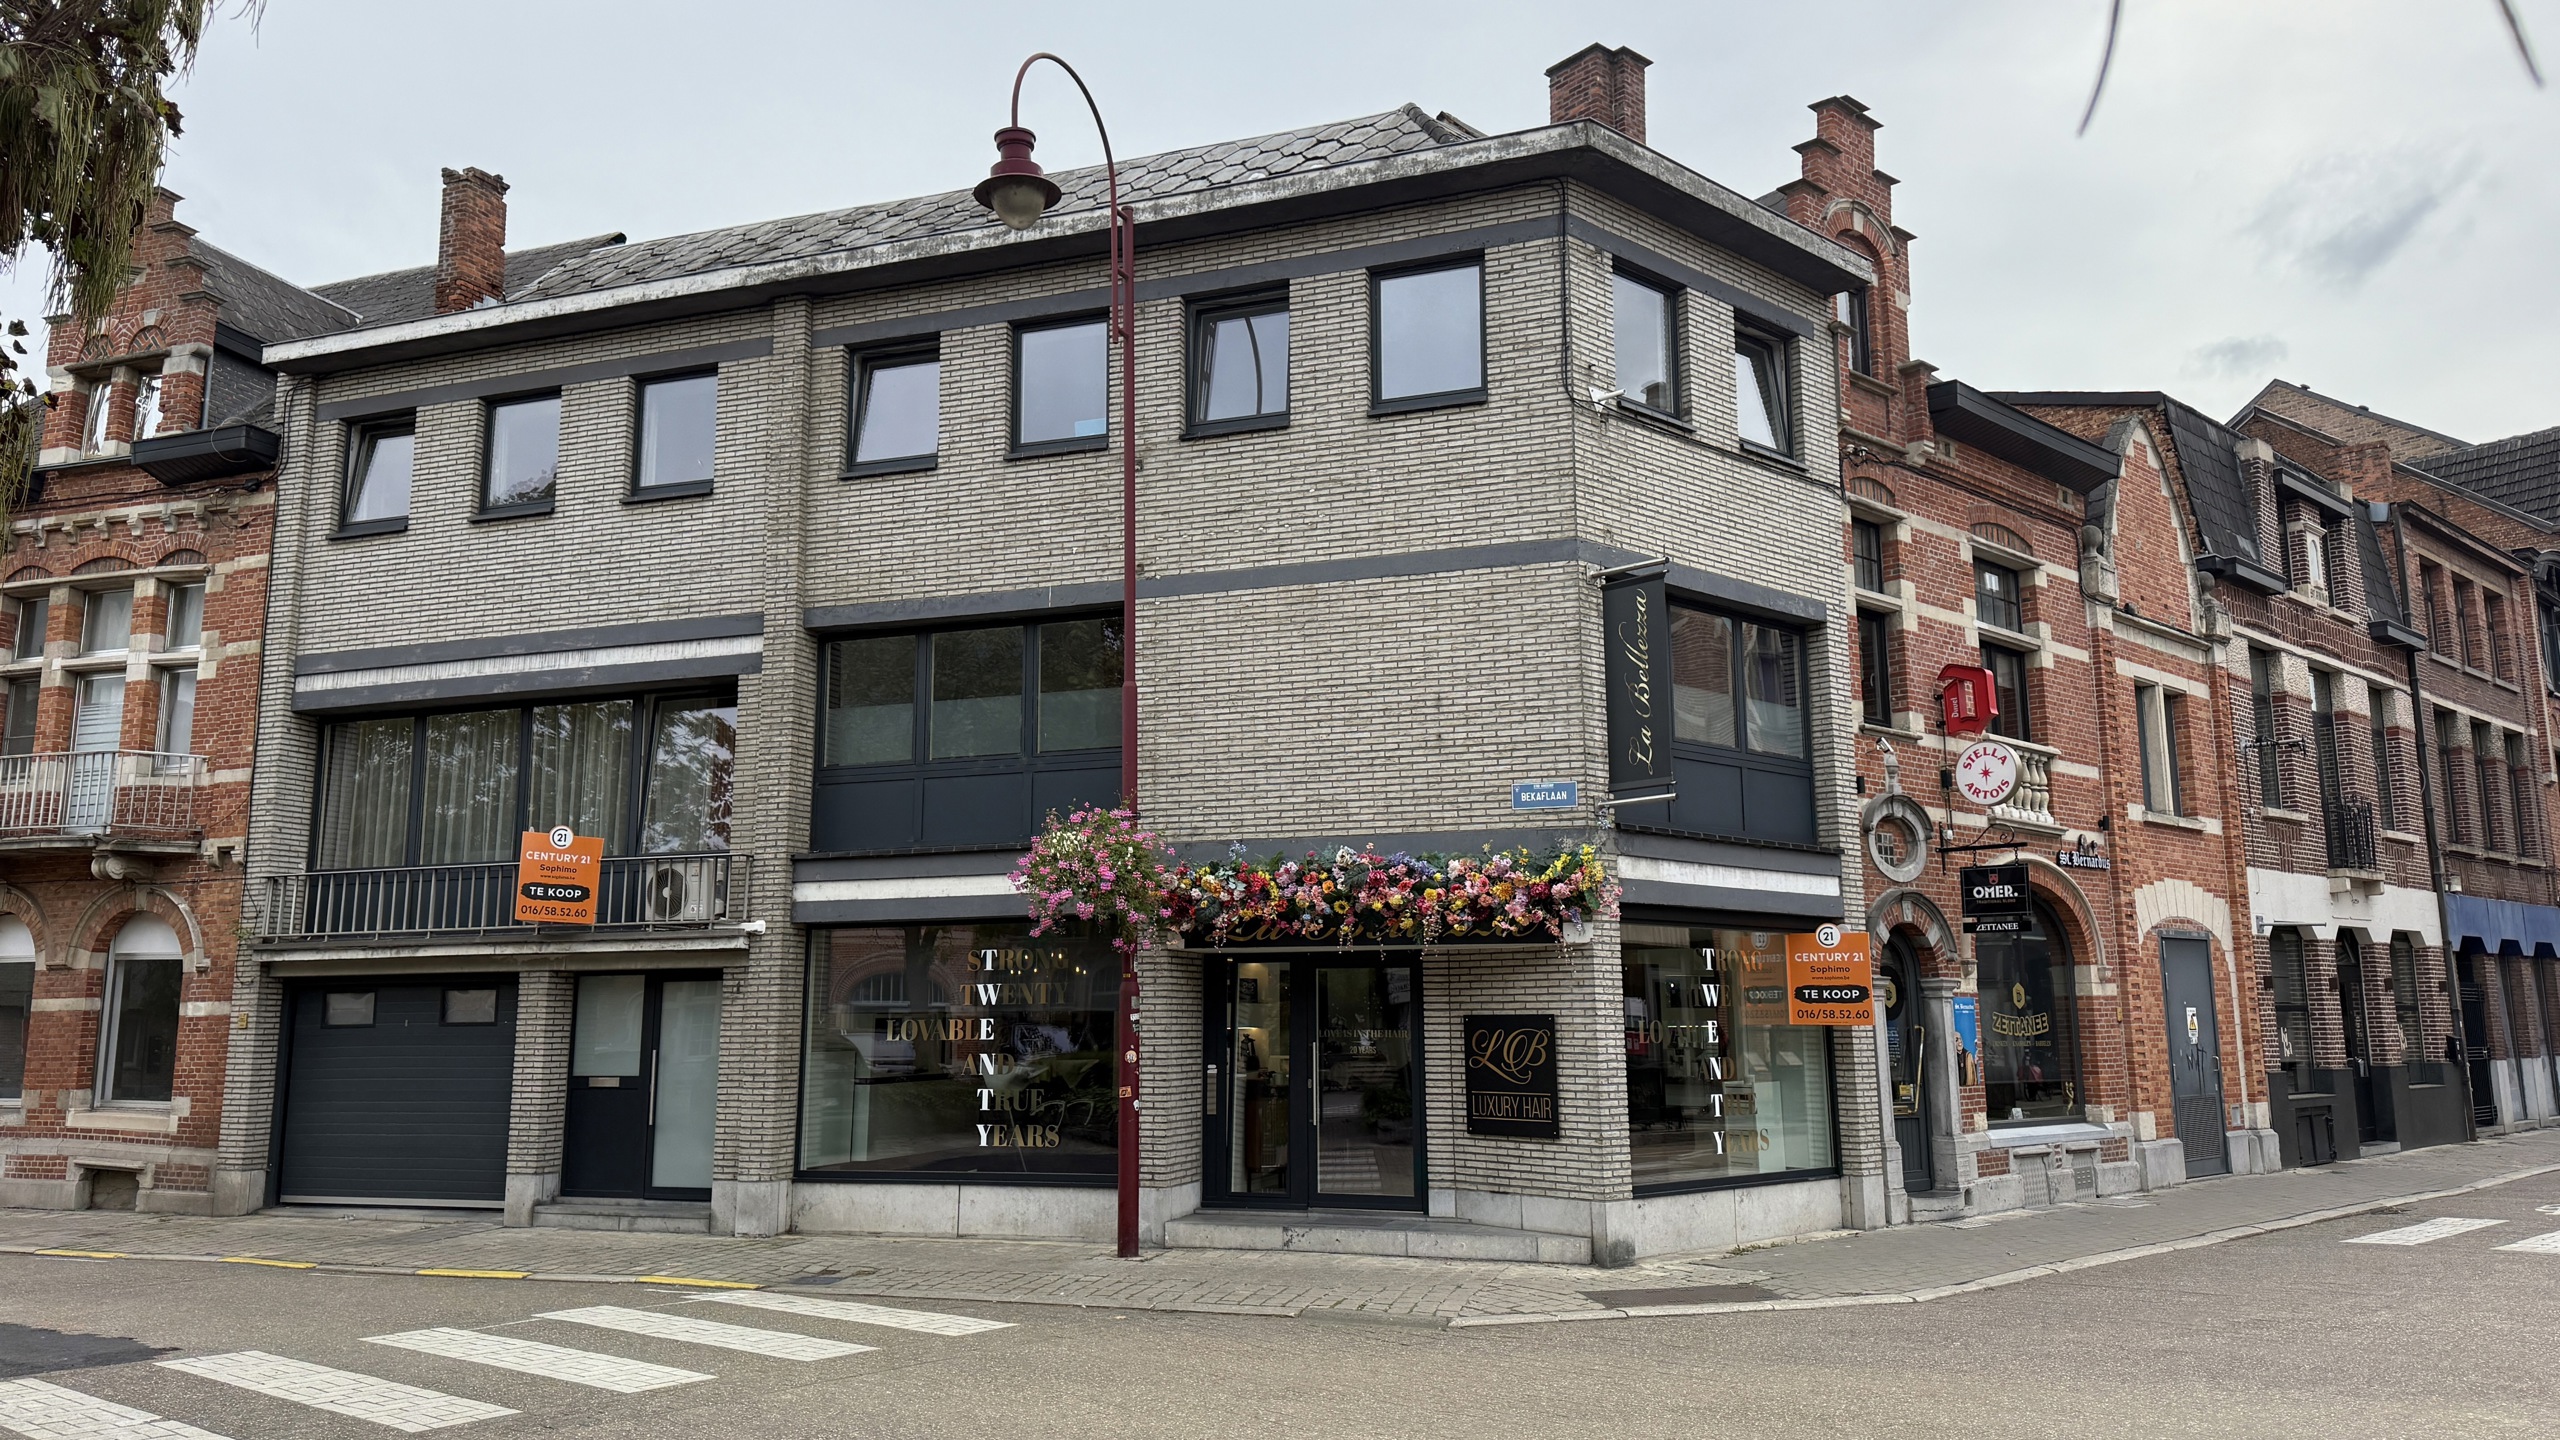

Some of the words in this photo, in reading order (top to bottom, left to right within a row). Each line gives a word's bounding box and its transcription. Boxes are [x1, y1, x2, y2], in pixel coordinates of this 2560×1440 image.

[1618, 588, 1652, 719] Bellezza
[1628, 725, 1654, 776] La
[1962, 747, 2008, 770] STELLA
[1521, 791, 1567, 802] BEKAFLAAN
[1964, 778, 2010, 800] ARTOIS
[526, 850, 578, 863] CENTURY
[580, 855, 591, 864] 21
[2072, 851, 2111, 870] Bernardus
[540, 864, 577, 874] Sophimo
[529, 886, 544, 896] TE
[548, 887, 582, 898] KOOP
[521, 905, 588, 918] 016/58.52.60
[1976, 922, 2019, 932] ZETTANEE
[967, 947, 1070, 972] STRONG
[1794, 952, 1849, 962] CENTURY
[1852, 952, 1864, 962] 21
[1810, 965, 1851, 974] Sophimo
[960, 982, 1068, 1007] TWENTY
[1803, 990, 1819, 999] TE
[1823, 989, 1860, 999] KOOP
[1797, 1008, 1870, 1021] 016/58.52.60
[1992, 1011, 2049, 1037] ZETTANEE
[886, 1018, 994, 1042] LOVABLE
[1319, 1029, 1342, 1038] LOVE
[1343, 1029, 1352, 1038] IS
[1385, 1029, 1409, 1039] HAIR
[1349, 1045, 1358, 1054] 20
[1358, 1045, 1378, 1054] YEARS
[961, 1053, 1015, 1076] AND
[1698, 1057, 1736, 1081] AND
[977, 1088, 1046, 1112] TRUE
[1472, 1095, 1519, 1118] LUXURY
[1523, 1097, 1552, 1119] HAIR
[976, 1124, 1060, 1148] YEARS
